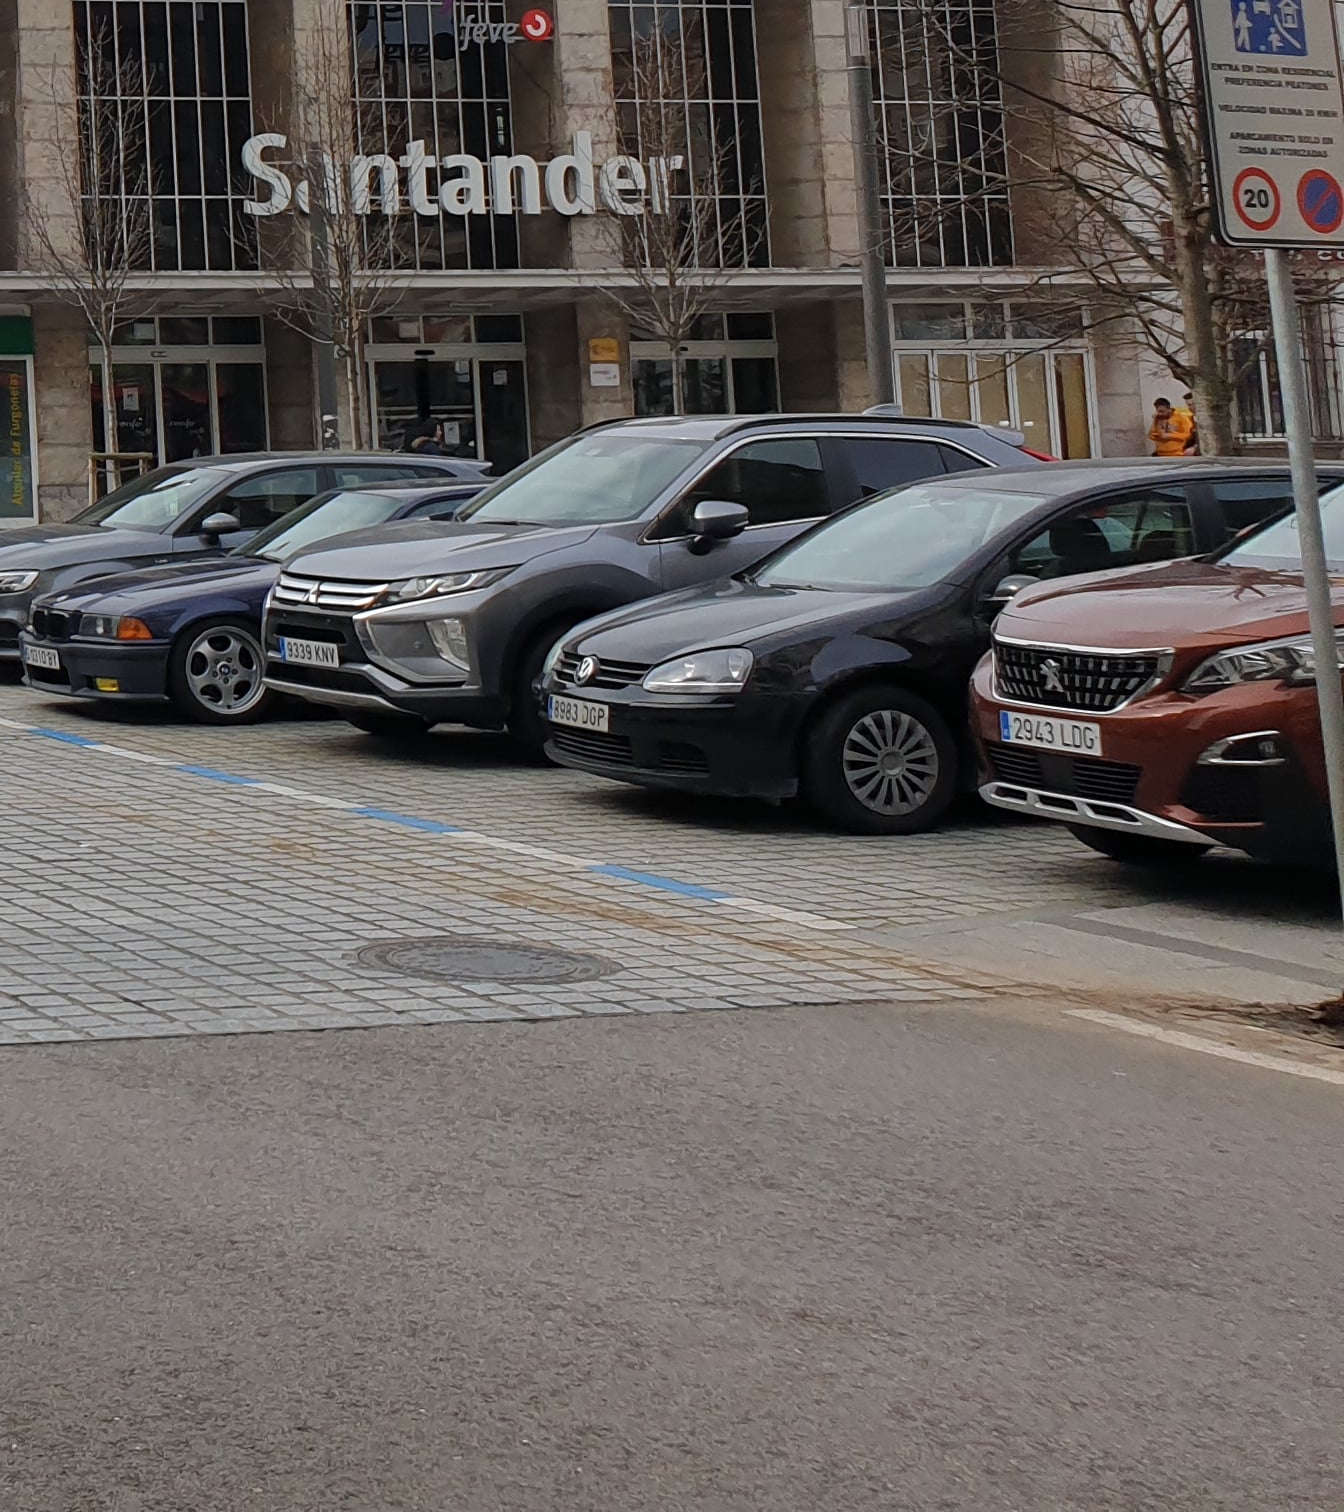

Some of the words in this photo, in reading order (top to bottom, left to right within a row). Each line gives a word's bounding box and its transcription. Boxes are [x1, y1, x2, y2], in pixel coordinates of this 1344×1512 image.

[459, 14, 518, 51] feve
[241, 131, 685, 217] Santander
[1243, 188, 1270, 209] 20
[287, 641, 312, 660] 9339
[314, 645, 335, 664] KNV
[554, 700, 578, 722] 8983
[582, 705, 605, 726] DGP
[1013, 717, 1055, 744] 2943
[1059, 723, 1095, 749] LDG
